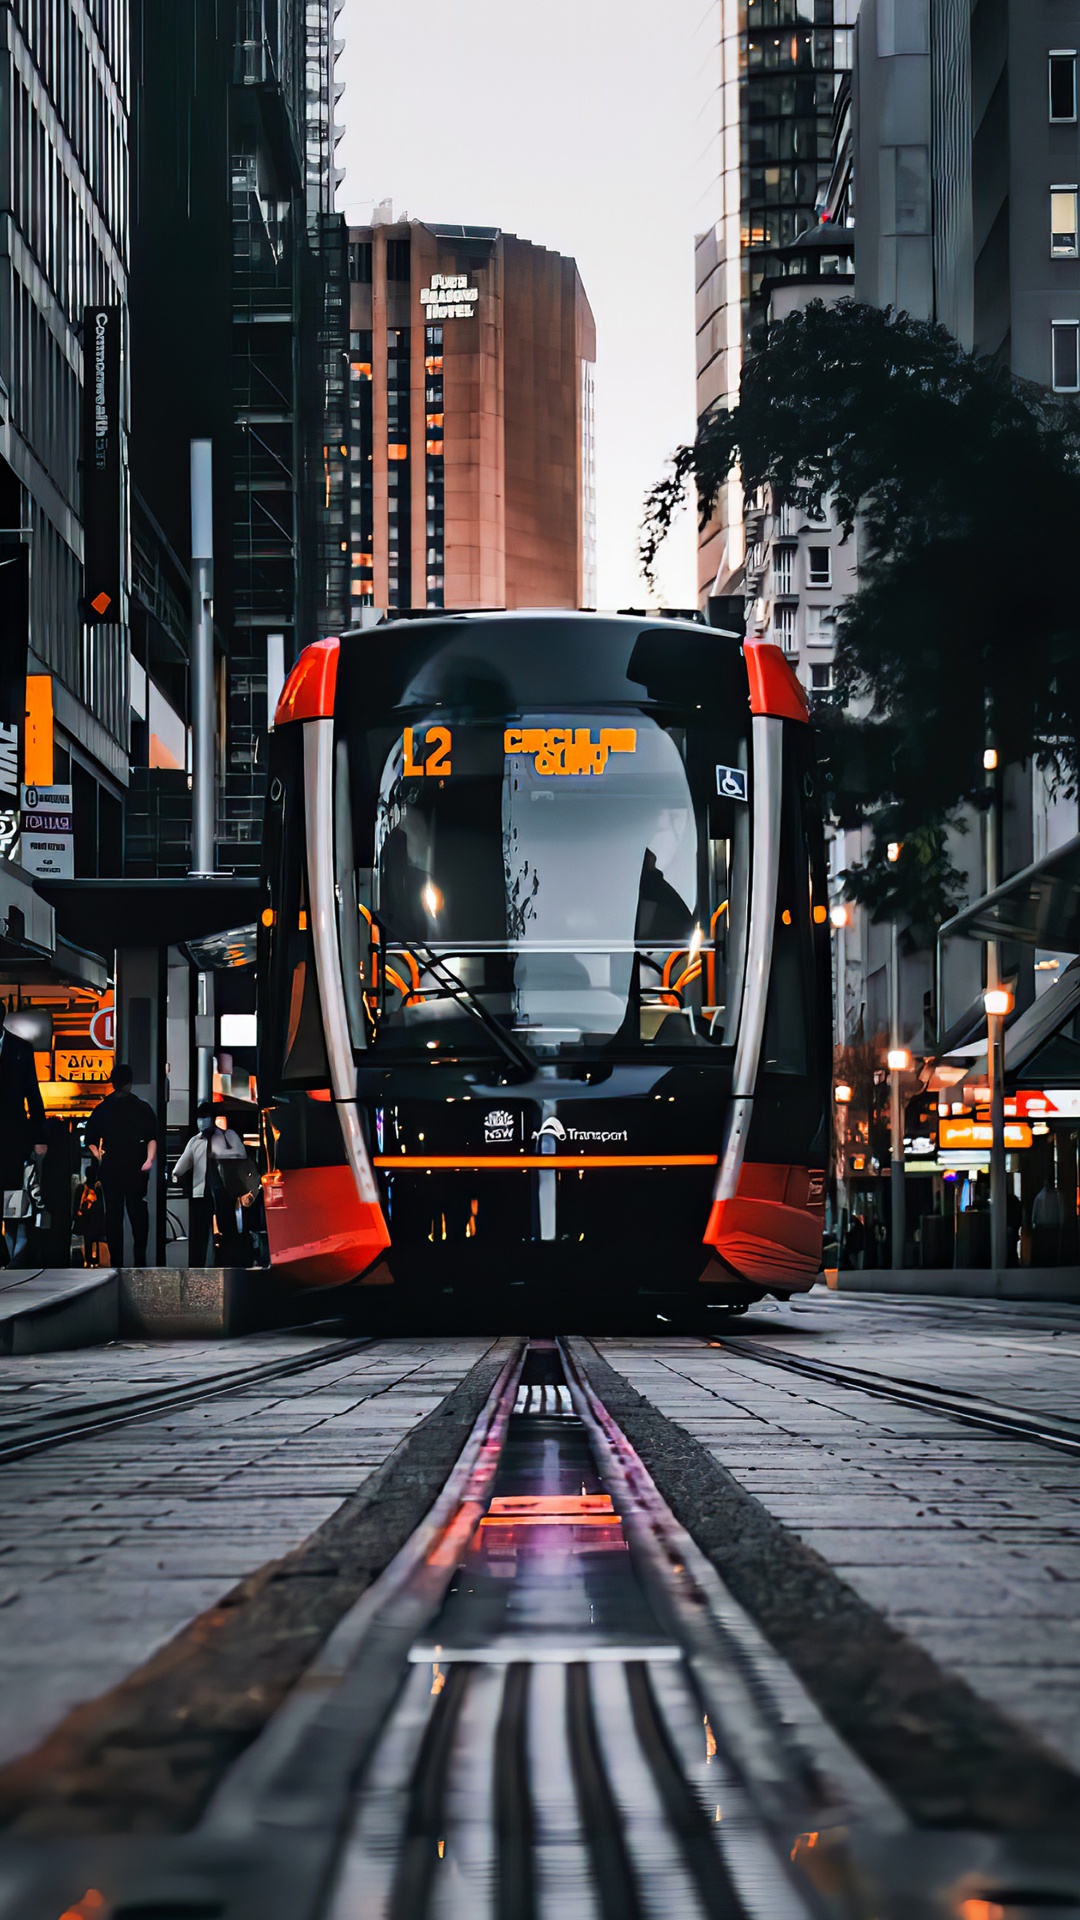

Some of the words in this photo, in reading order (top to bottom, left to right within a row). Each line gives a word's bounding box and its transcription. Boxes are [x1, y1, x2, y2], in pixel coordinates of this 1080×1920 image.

[0, 722, 18, 796] NIKE
[402, 727, 452, 776] L2
[484, 1127, 514, 1140] NSW
[566, 1128, 628, 1142] Transport
